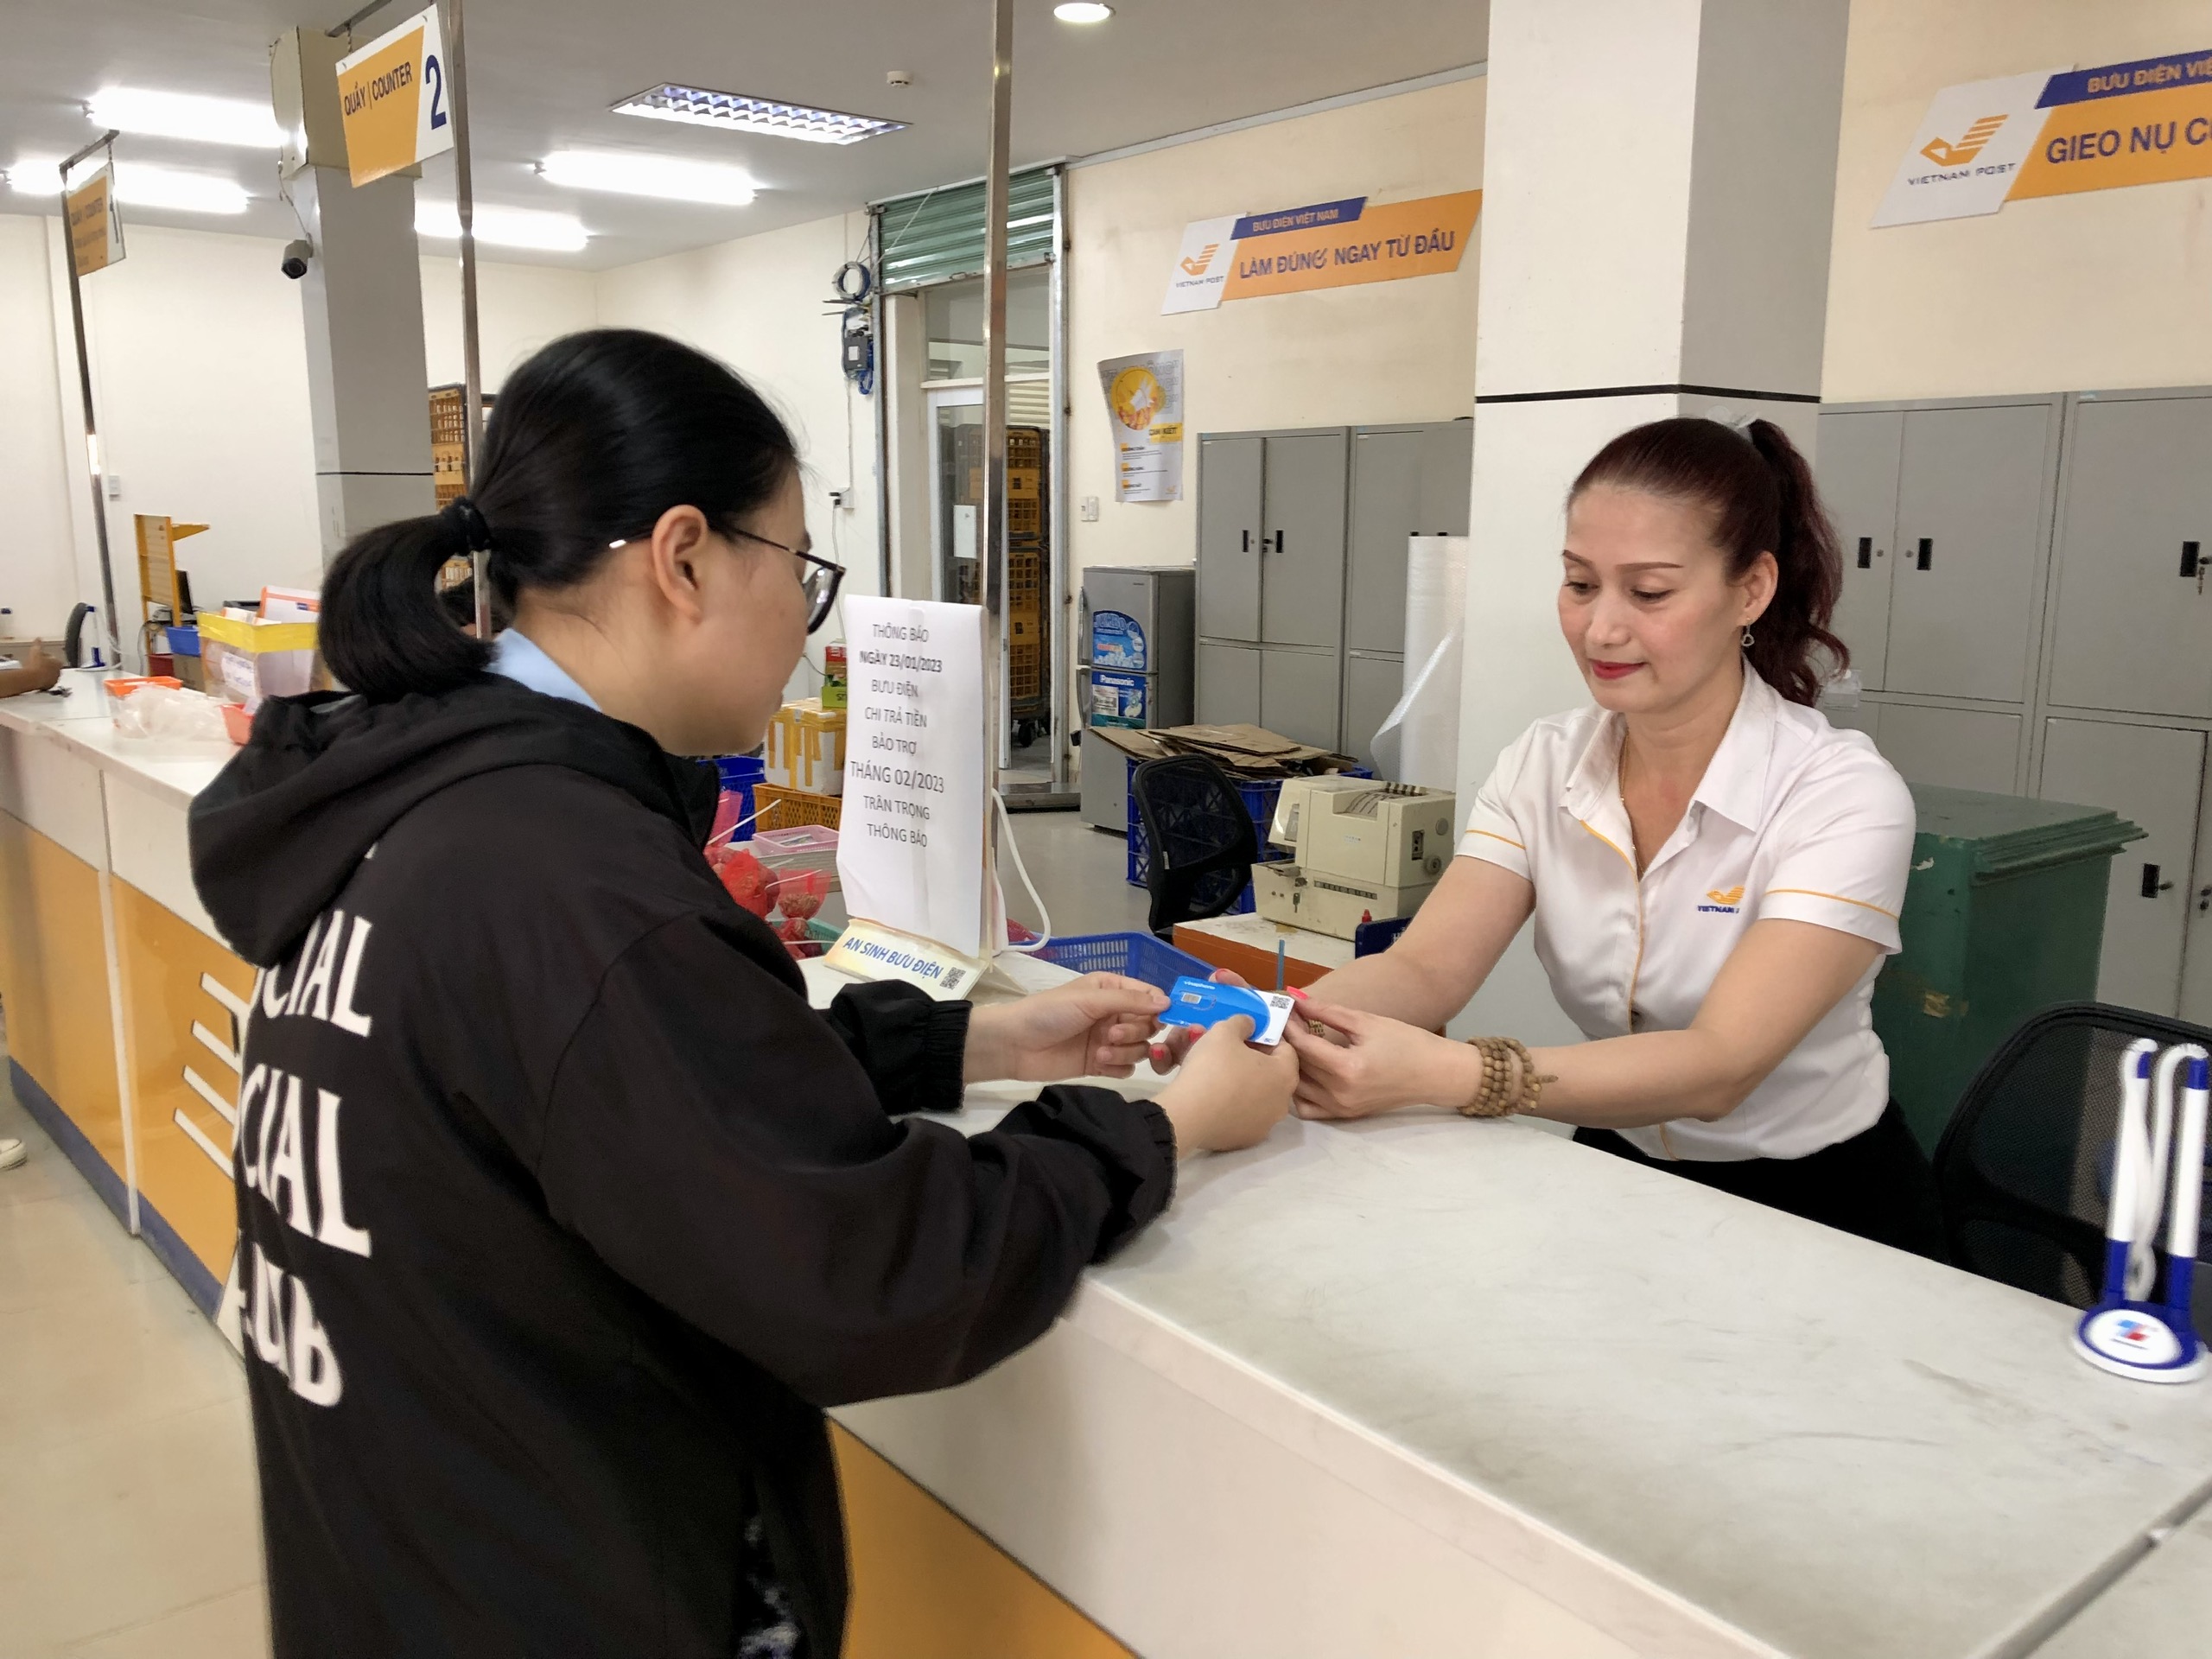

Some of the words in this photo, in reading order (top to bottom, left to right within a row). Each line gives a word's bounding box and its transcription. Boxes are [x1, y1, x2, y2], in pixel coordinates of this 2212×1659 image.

[371, 61, 414, 102] COUNTER
[2087, 72, 2130, 94] BƯU
[2133, 62, 2183, 86] ĐIỆN
[425, 54, 447, 130] 2
[2045, 129, 2122, 164] GIEO
[2129, 120, 2177, 155] NỤ
[2184, 117, 2212, 146] C
[1907, 169, 1971, 186] VIETNAM
[1975, 162, 2017, 176] POST
[1252, 219, 1272, 232] BƯU
[1295, 211, 1316, 226] VIỆT
[1317, 208, 1339, 221] NAM
[1240, 256, 1273, 279] LÀM
[1333, 240, 1382, 266] NGAY
[1385, 232, 1411, 258] TỪ
[1414, 227, 1456, 255] ĐẦU
[1175, 278, 1204, 289] VIETNAM
[1205, 275, 1224, 285] POST
[872, 621, 907, 641] THÔNG
[909, 624, 930, 643] BÁO
[859, 649, 888, 665] NGÀY
[889, 653, 943, 673] 23/01/2023
[871, 679, 895, 694] BƯU
[896, 681, 919, 699] ĐIỆN
[1099, 674, 1135, 687] Panasonic
[864, 707, 881, 721] CHI
[883, 706, 903, 725] TRẢ
[905, 708, 928, 728] TIỀN
[872, 731, 894, 751] BẢO
[895, 739, 918, 757] TRỢ
[849, 760, 892, 784] THÁNG
[894, 768, 944, 793] 02/2023
[862, 794, 893, 813] TRÂN
[893, 799, 931, 820] TRỌNG
[866, 823, 907, 842] THÔNG
[910, 829, 928, 848] BÁO
[842, 936, 862, 950] AN
[859, 941, 891, 963] SINH
[887, 950, 915, 969] BƯU
[911, 958, 944, 979] ĐIỆN
[245, 1241, 343, 1408] UB
